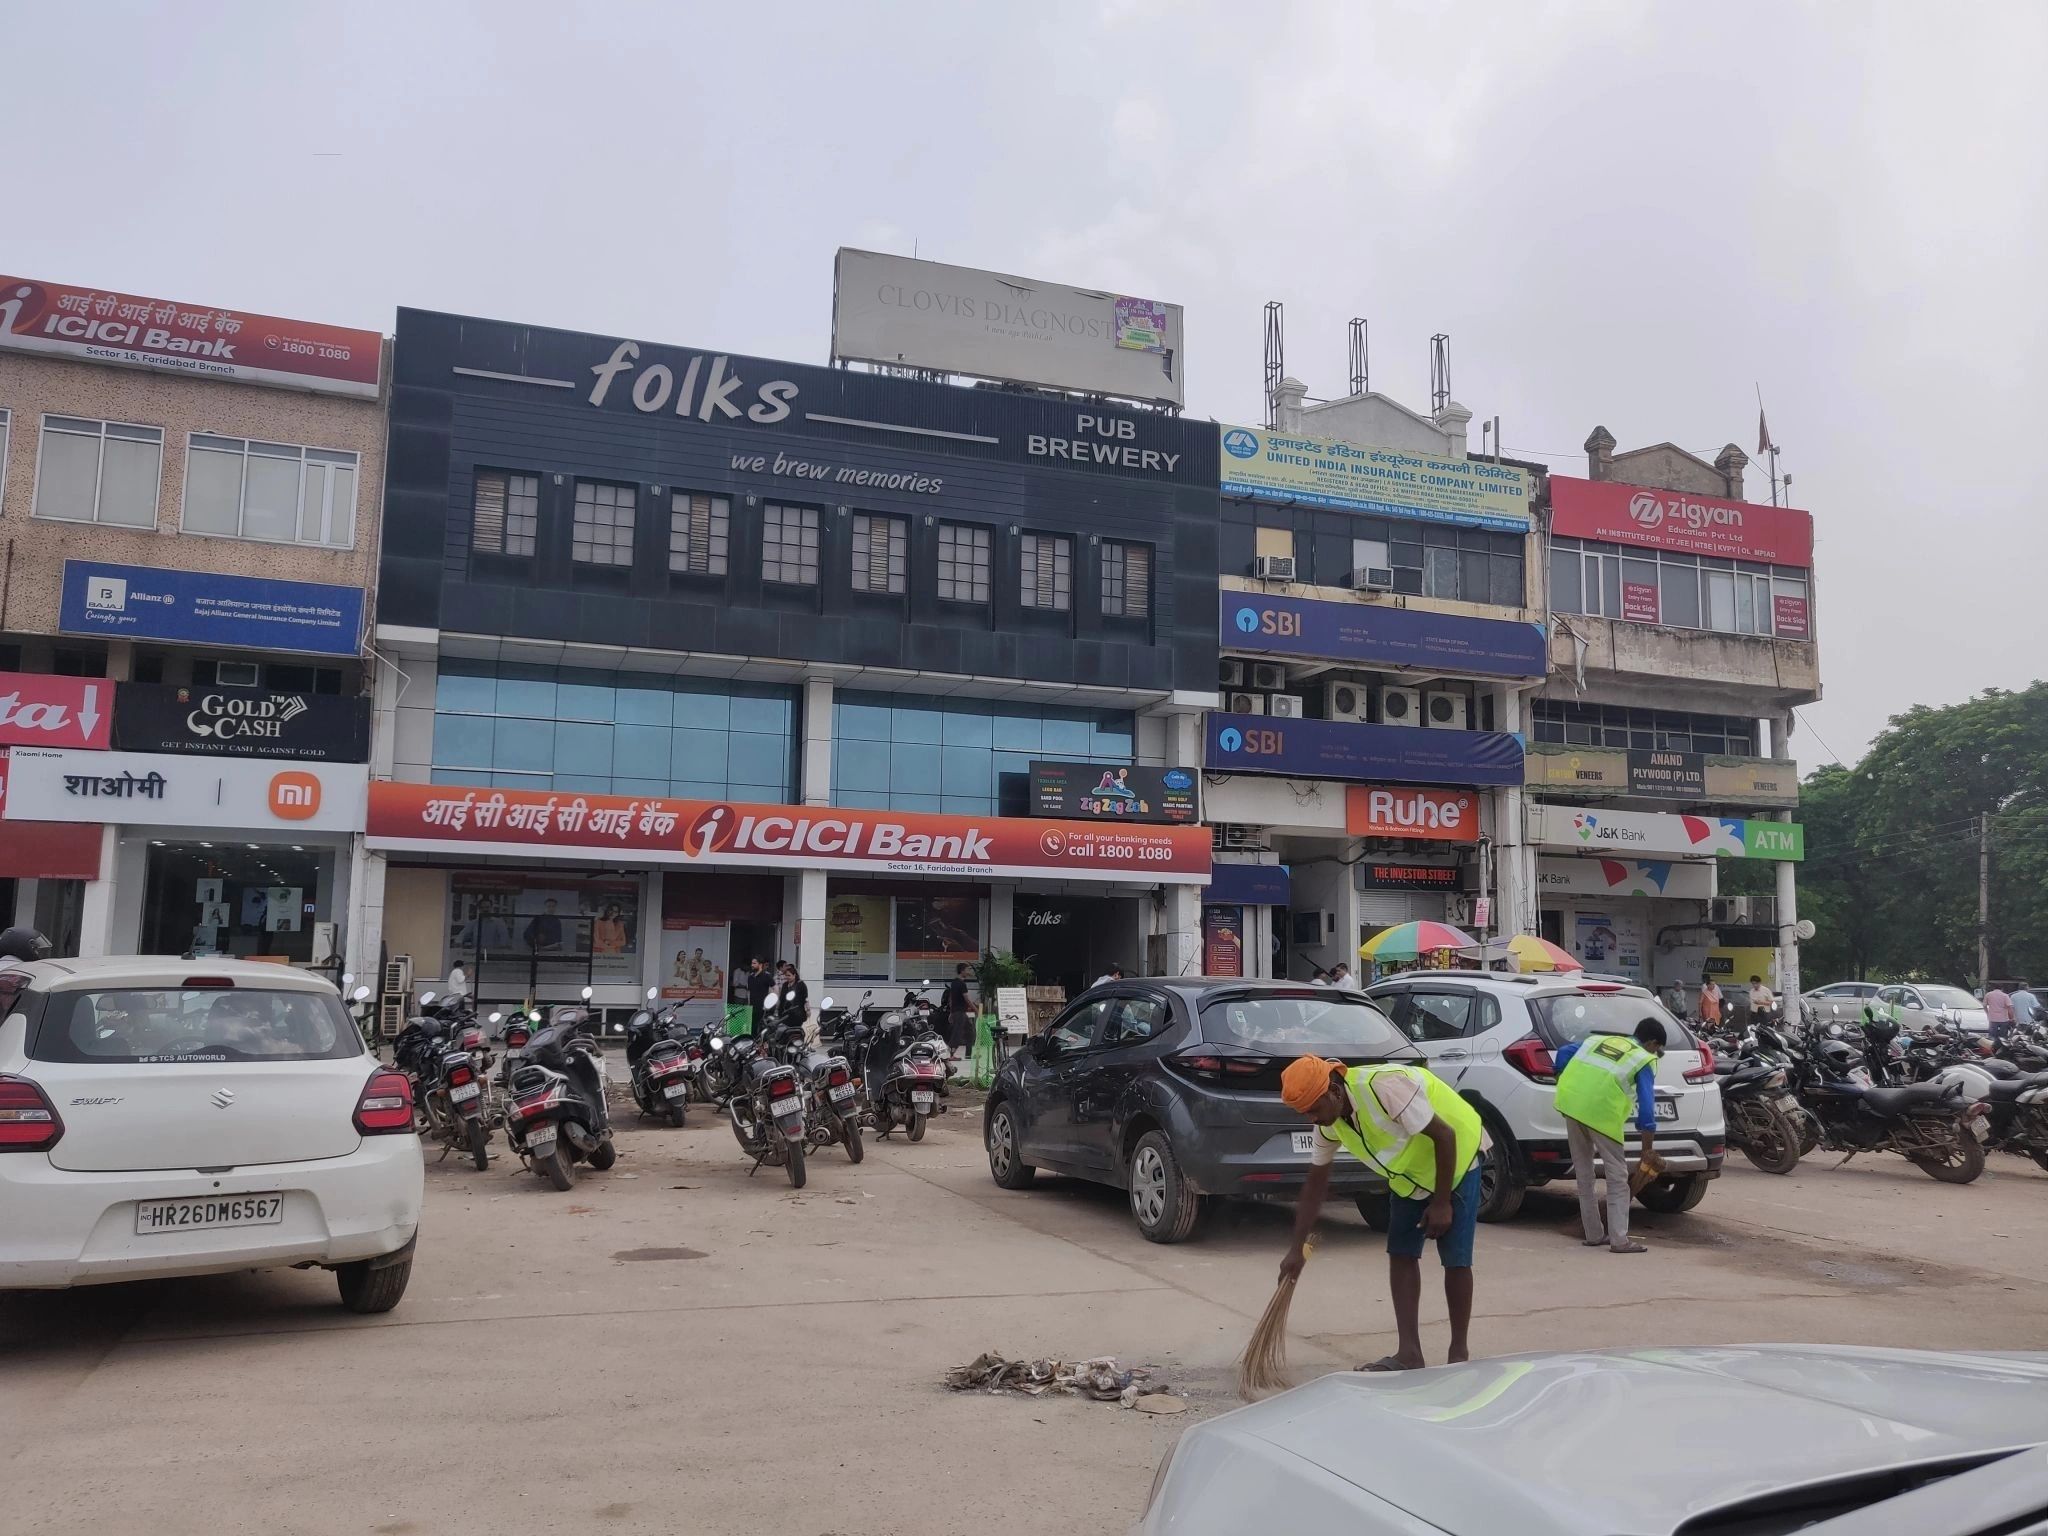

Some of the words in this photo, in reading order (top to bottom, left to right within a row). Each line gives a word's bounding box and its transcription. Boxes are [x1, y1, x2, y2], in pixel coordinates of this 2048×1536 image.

[878, 284, 975, 318] CLOVIS
[57, 292, 96, 316] आई
[95, 294, 117, 317] सी
[117, 301, 155, 325] आई
[155, 303, 177, 325] सी
[178, 311, 214, 334] आई
[214, 312, 244, 335] बैंक
[44, 314, 139, 344] ICICI
[143, 328, 237, 359] Bank
[86, 347, 120, 358] Sector
[124, 352, 139, 362] 16,
[142, 354, 196, 369] Faridabad
[199, 362, 235, 374] Branch
[283, 342, 315, 355] 1800
[319, 347, 350, 360] 1080
[588, 340, 800, 423] folks
[1077, 413, 1136, 440] PUB
[1027, 434, 1181, 474] BREWERY
[1267, 436, 1322, 454] युनाइटेड
[1327, 443, 1365, 459] इंडिया
[1427, 460, 1471, 475] कम्पनी
[1475, 464, 1521, 482] लिमिटेड
[731, 454, 766, 473] we
[772, 452, 830, 480] brew
[835, 466, 943, 495] memories
[1267, 451, 1310, 467] UNITED
[1314, 458, 1347, 472] INDIA
[1351, 463, 1416, 482] INSURANCE
[1421, 474, 1475, 490] COMPANY
[1479, 483, 1522, 496] LIMITED
[1317, 477, 1348, 487] REGISTERED
[1667, 498, 1743, 529] zigyan
[1609, 529, 1645, 541] INSTITUTE
[1676, 539, 1689, 547] JEE
[1695, 541, 1713, 550] NTSE
[1718, 544, 1736, 552] KVPY
[1668, 525, 1707, 538] Education
[1711, 531, 1725, 540] Pvt
[1729, 533, 1743, 542] Ltd
[130, 592, 162, 602] Allianz
[1634, 586, 1651, 594] zigyan
[85, 610, 116, 623] Caringly
[118, 616, 137, 624] yours
[194, 608, 210, 617] Bajaj
[211, 610, 232, 618] Allianz
[233, 612, 257, 620] General
[258, 614, 287, 622] Insurance
[288, 616, 316, 626] Company
[317, 619, 340, 627] Limited
[1642, 605, 1656, 613] Side
[1262, 610, 1302, 637] SBI
[1777, 615, 1792, 623] Back
[201, 695, 275, 718] GOLD
[214, 718, 282, 739] CASH
[185, 742, 224, 751] INSTANT
[257, 746, 296, 754] AGAINST
[1244, 729, 1284, 755] SBI
[1651, 753, 1682, 766] ANAND
[64, 770, 167, 798] शाओमी
[1576, 770, 1603, 780] VENEERS
[1633, 768, 1671, 780] PLYWOOD
[1673, 769, 1684, 782] (P)
[1686, 770, 1703, 782] LTD.
[1753, 781, 1777, 792] VENEERS
[422, 793, 476, 831] आई
[474, 793, 505, 829] सी
[505, 797, 557, 835] आई
[557, 797, 588, 833] सी
[588, 801, 638, 839] आई
[639, 802, 678, 837] बैंक
[1369, 791, 1460, 829] Ruhe
[733, 816, 863, 853] ICICI
[868, 824, 995, 860] Bank
[1084, 833, 1094, 841] all
[1096, 835, 1114, 843] your
[1116, 835, 1147, 845] banking
[1596, 827, 1619, 839] J&K
[1621, 828, 1646, 841] Bank
[1755, 831, 1794, 850] ATM
[1069, 844, 1094, 857] call
[1099, 845, 1133, 858] 1800
[1138, 847, 1172, 860] 1080
[887, 862, 912, 871] Sector
[914, 863, 925, 872] 16,
[927, 864, 965, 873] Faridabad
[967, 865, 993, 874] Branch
[1373, 867, 1389, 879] THE
[1391, 868, 1427, 880] INVESTOR
[1428, 869, 1456, 881] STREET
[1550, 873, 1570, 884] Bank
[1027, 911, 1062, 926] folks
[1687, 960, 1703, 968] NEW
[1706, 960, 1729, 969] MIKA
[1300, 1136, 1314, 1148] HR
[152, 1199, 280, 1226] HR26DM6567
